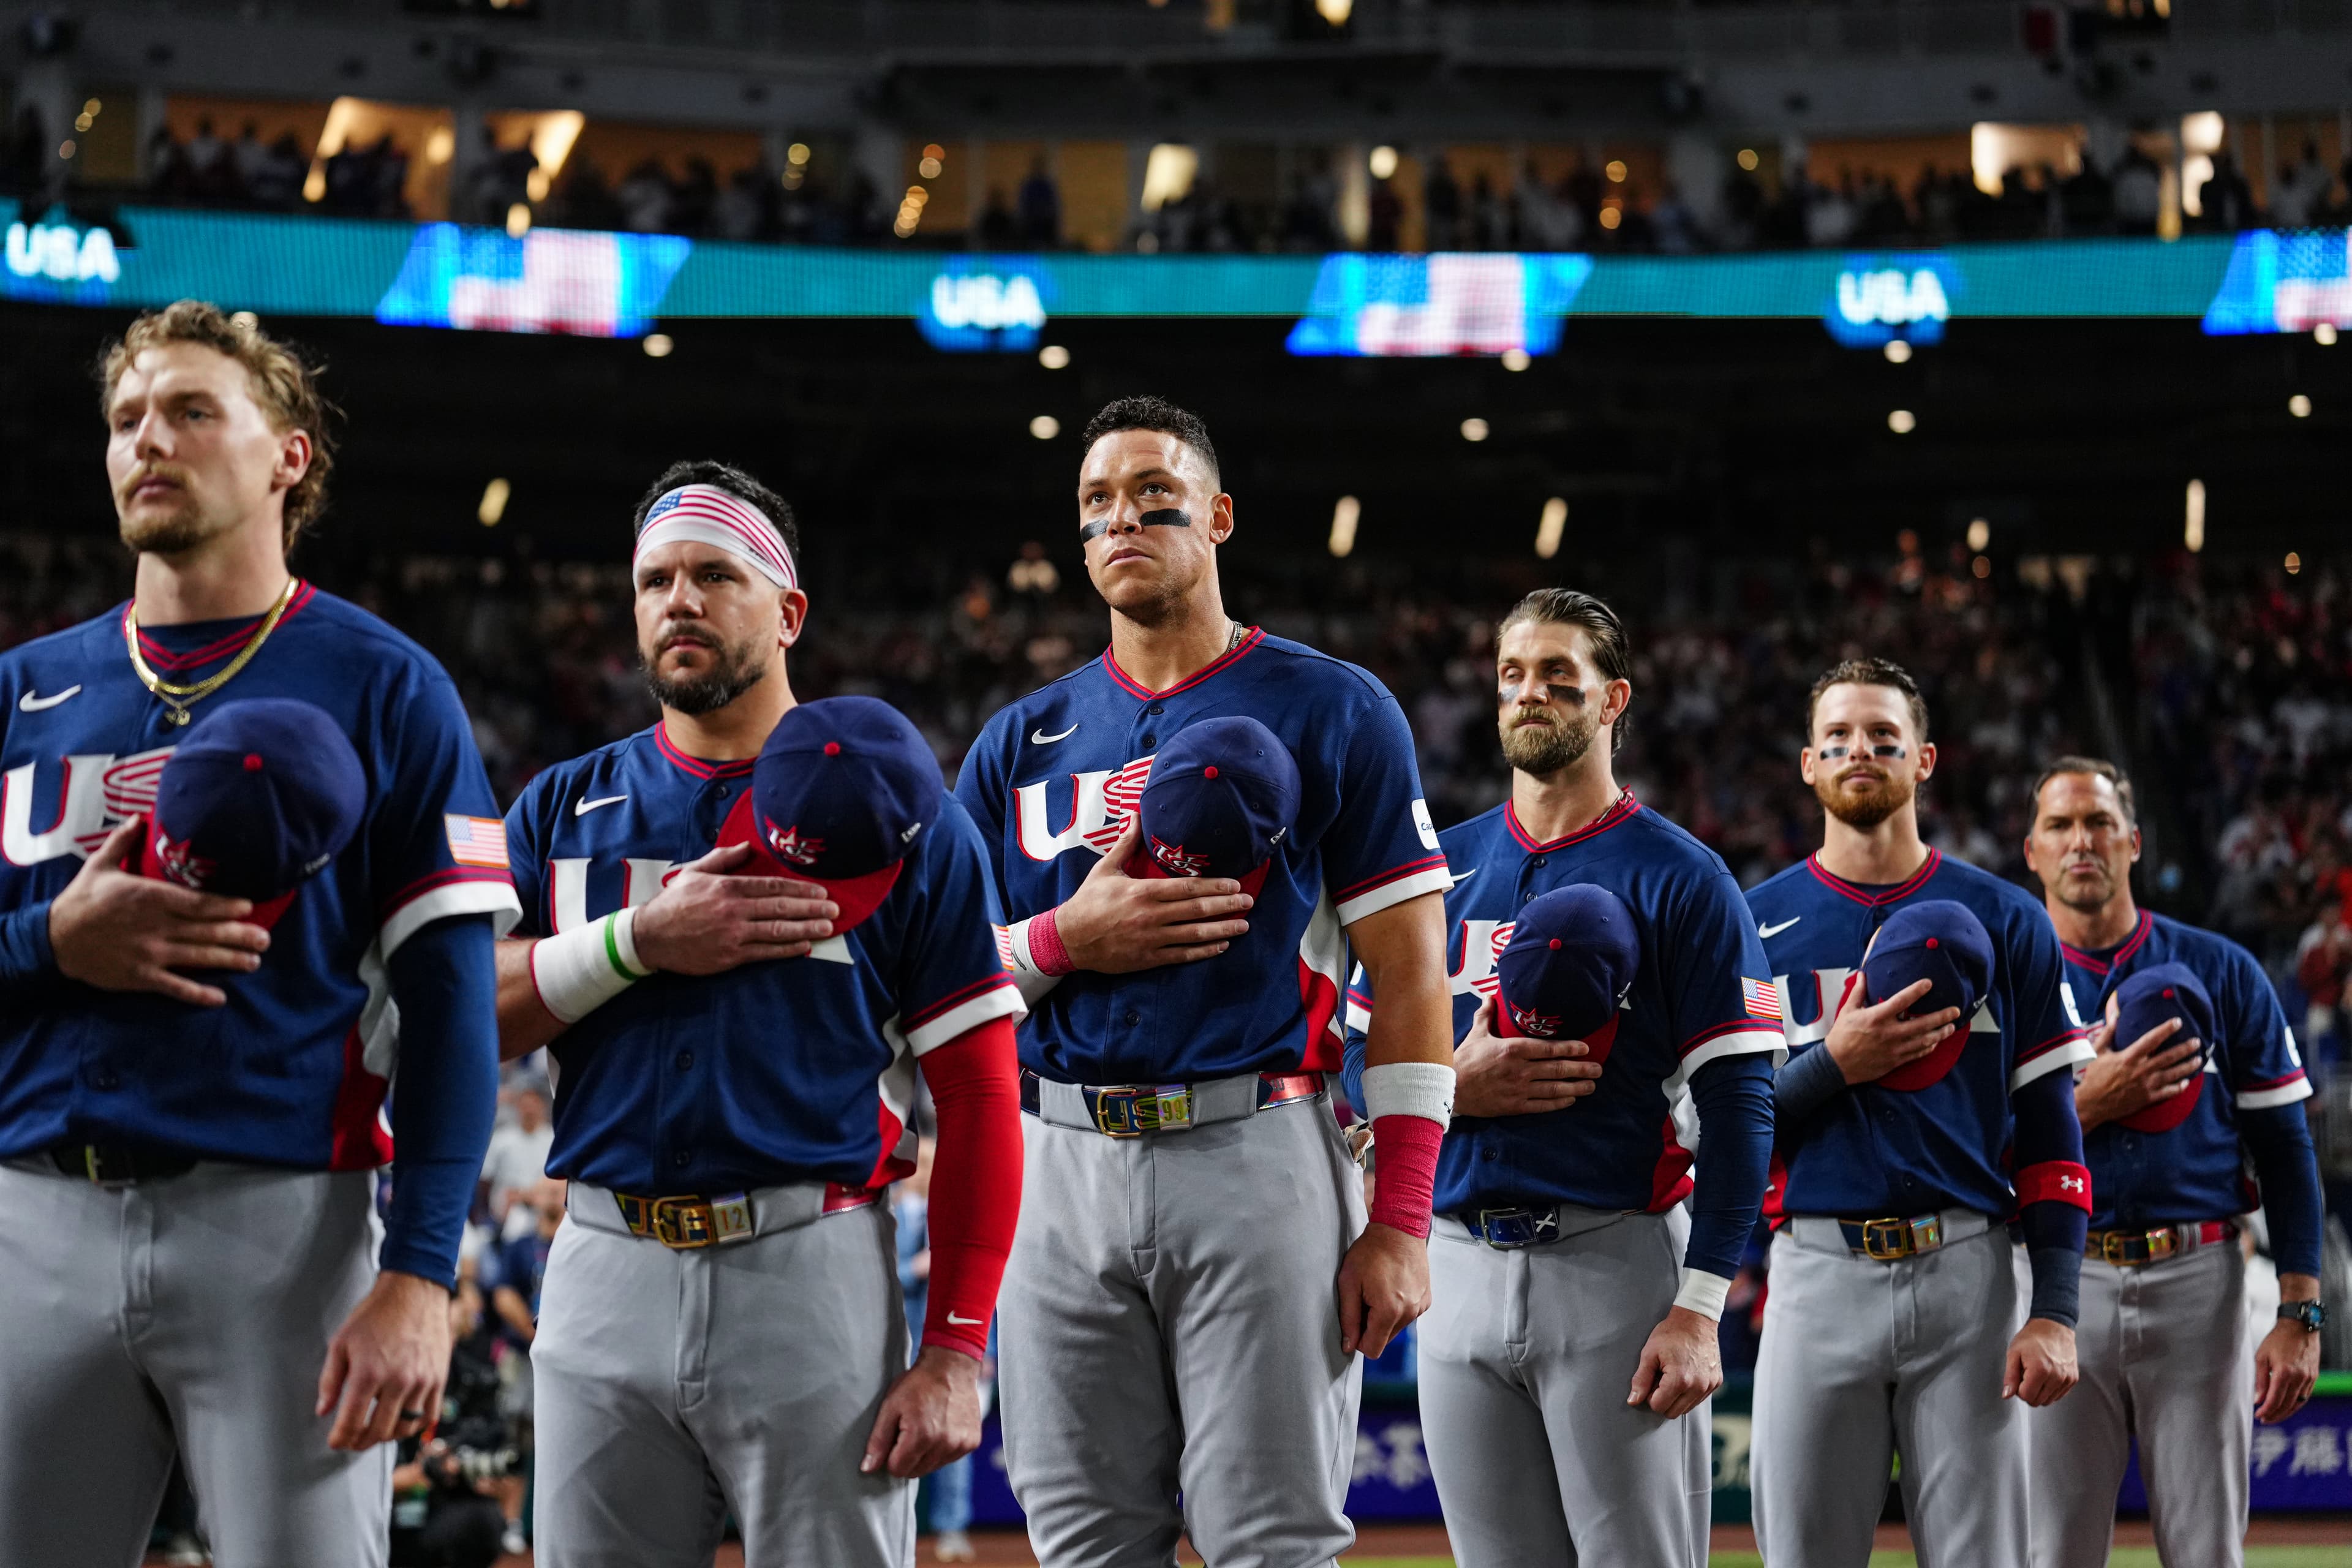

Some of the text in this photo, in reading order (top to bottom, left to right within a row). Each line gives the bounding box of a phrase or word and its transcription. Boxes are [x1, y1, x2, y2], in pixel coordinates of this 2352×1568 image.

[5, 222, 120, 282] USA
[931, 273, 1046, 329] USA
[1838, 266, 1948, 325] USA
[1, 746, 178, 867] US
[1012, 754, 1157, 862] US
[1161, 1098, 1185, 1121] 99
